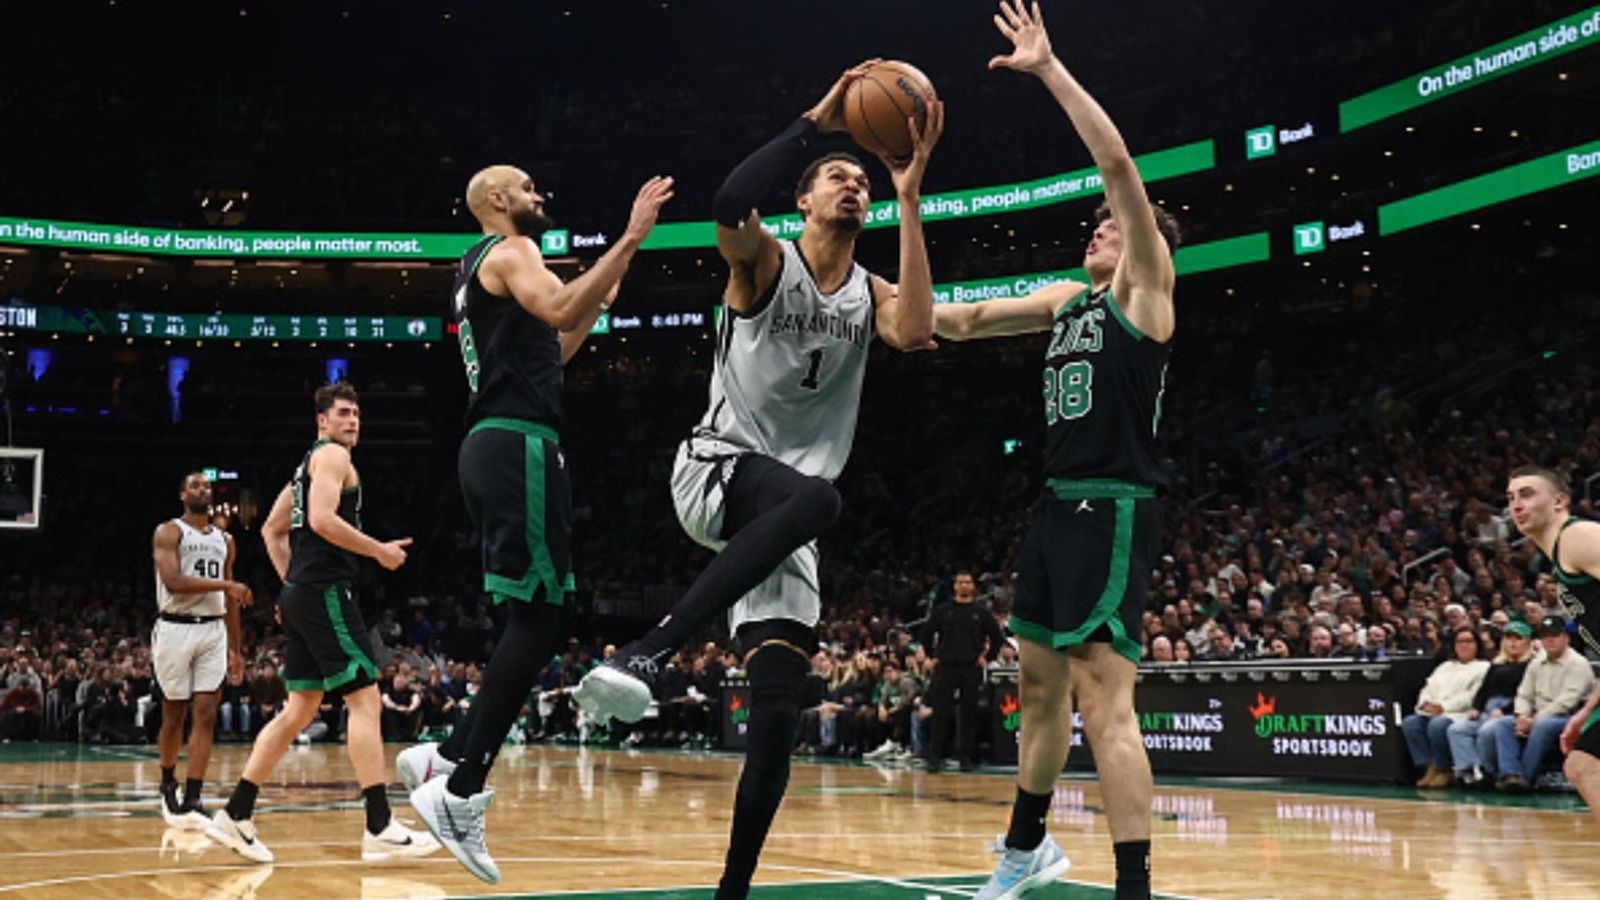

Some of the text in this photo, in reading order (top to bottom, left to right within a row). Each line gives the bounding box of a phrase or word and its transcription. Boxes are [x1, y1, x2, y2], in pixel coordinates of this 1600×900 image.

[1418, 11, 1600, 96] On the human side of
[1247, 122, 1314, 153] TD Bank
[876, 207, 892, 221] of
[972, 187, 1030, 210] people
[1033, 177, 1084, 201] matter
[16, 223, 45, 239] the
[48, 226, 109, 244] human
[113, 229, 150, 247] side
[153, 233, 171, 248] of
[175, 235, 249, 254] banking,
[252, 235, 312, 254] people
[314, 238, 373, 252] matter
[375, 239, 422, 253] most.
[572, 233, 607, 248] Bank
[1295, 220, 1365, 248] TD Bank
[953, 283, 1012, 302] Boston
[612, 316, 641, 328] Bank
[682, 313, 704, 327] PM
[800, 348, 824, 390] 1
[194, 557, 220, 579] 40
[1136, 712, 1225, 733] AFTKINGS
[1254, 714, 1387, 737] DRAFTKINGS
[1142, 734, 1213, 751] ORTSBOOK
[1273, 737, 1373, 757] SPORTSBOOK
